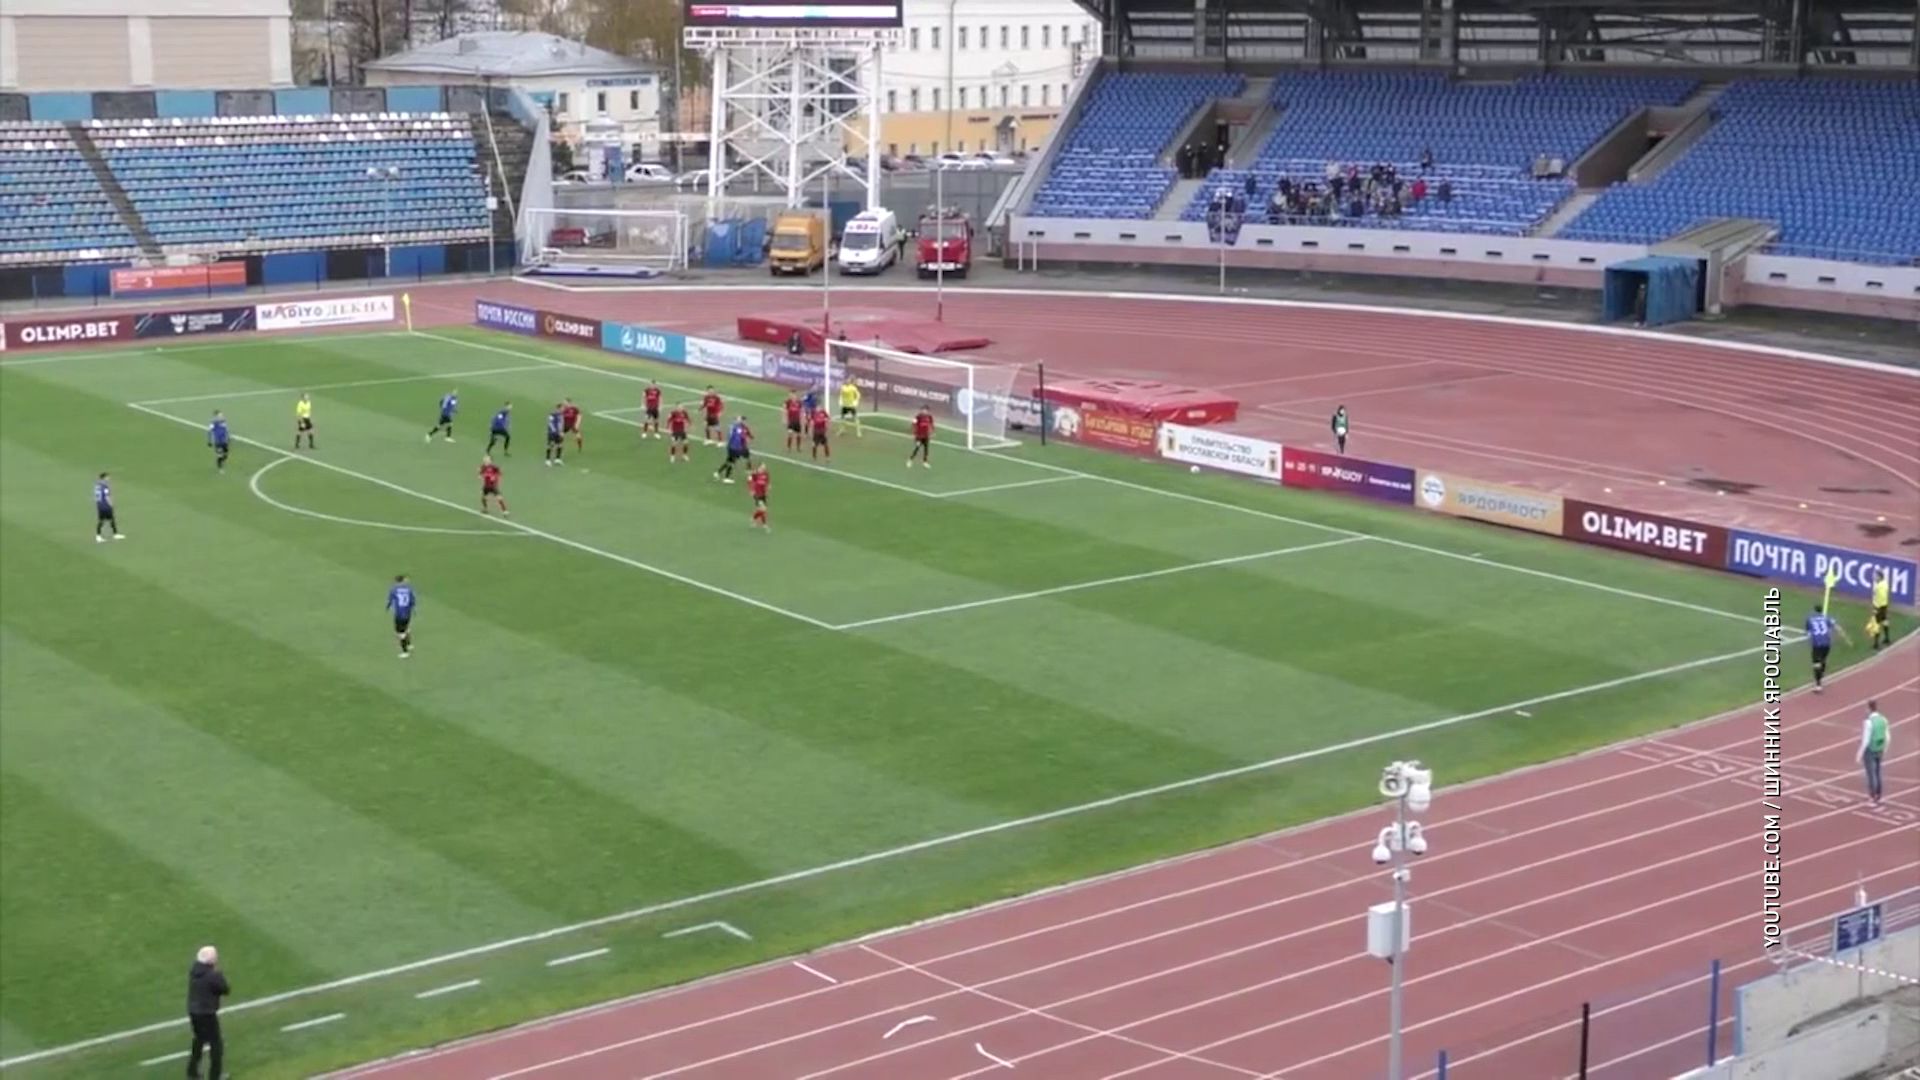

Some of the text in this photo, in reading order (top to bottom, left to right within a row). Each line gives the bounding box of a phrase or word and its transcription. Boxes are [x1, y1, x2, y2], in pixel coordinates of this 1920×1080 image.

[21, 321, 119, 343] OLIMP.BET
[636, 332, 666, 353] JAKO
[1458, 493, 1547, 519] ЯРДОРМОСТ
[1582, 511, 1708, 554] OLIMP.BET
[1734, 538, 1806, 576] ПОЧТА
[397, 593, 409, 607] 10
[1811, 621, 1828, 635] 33
